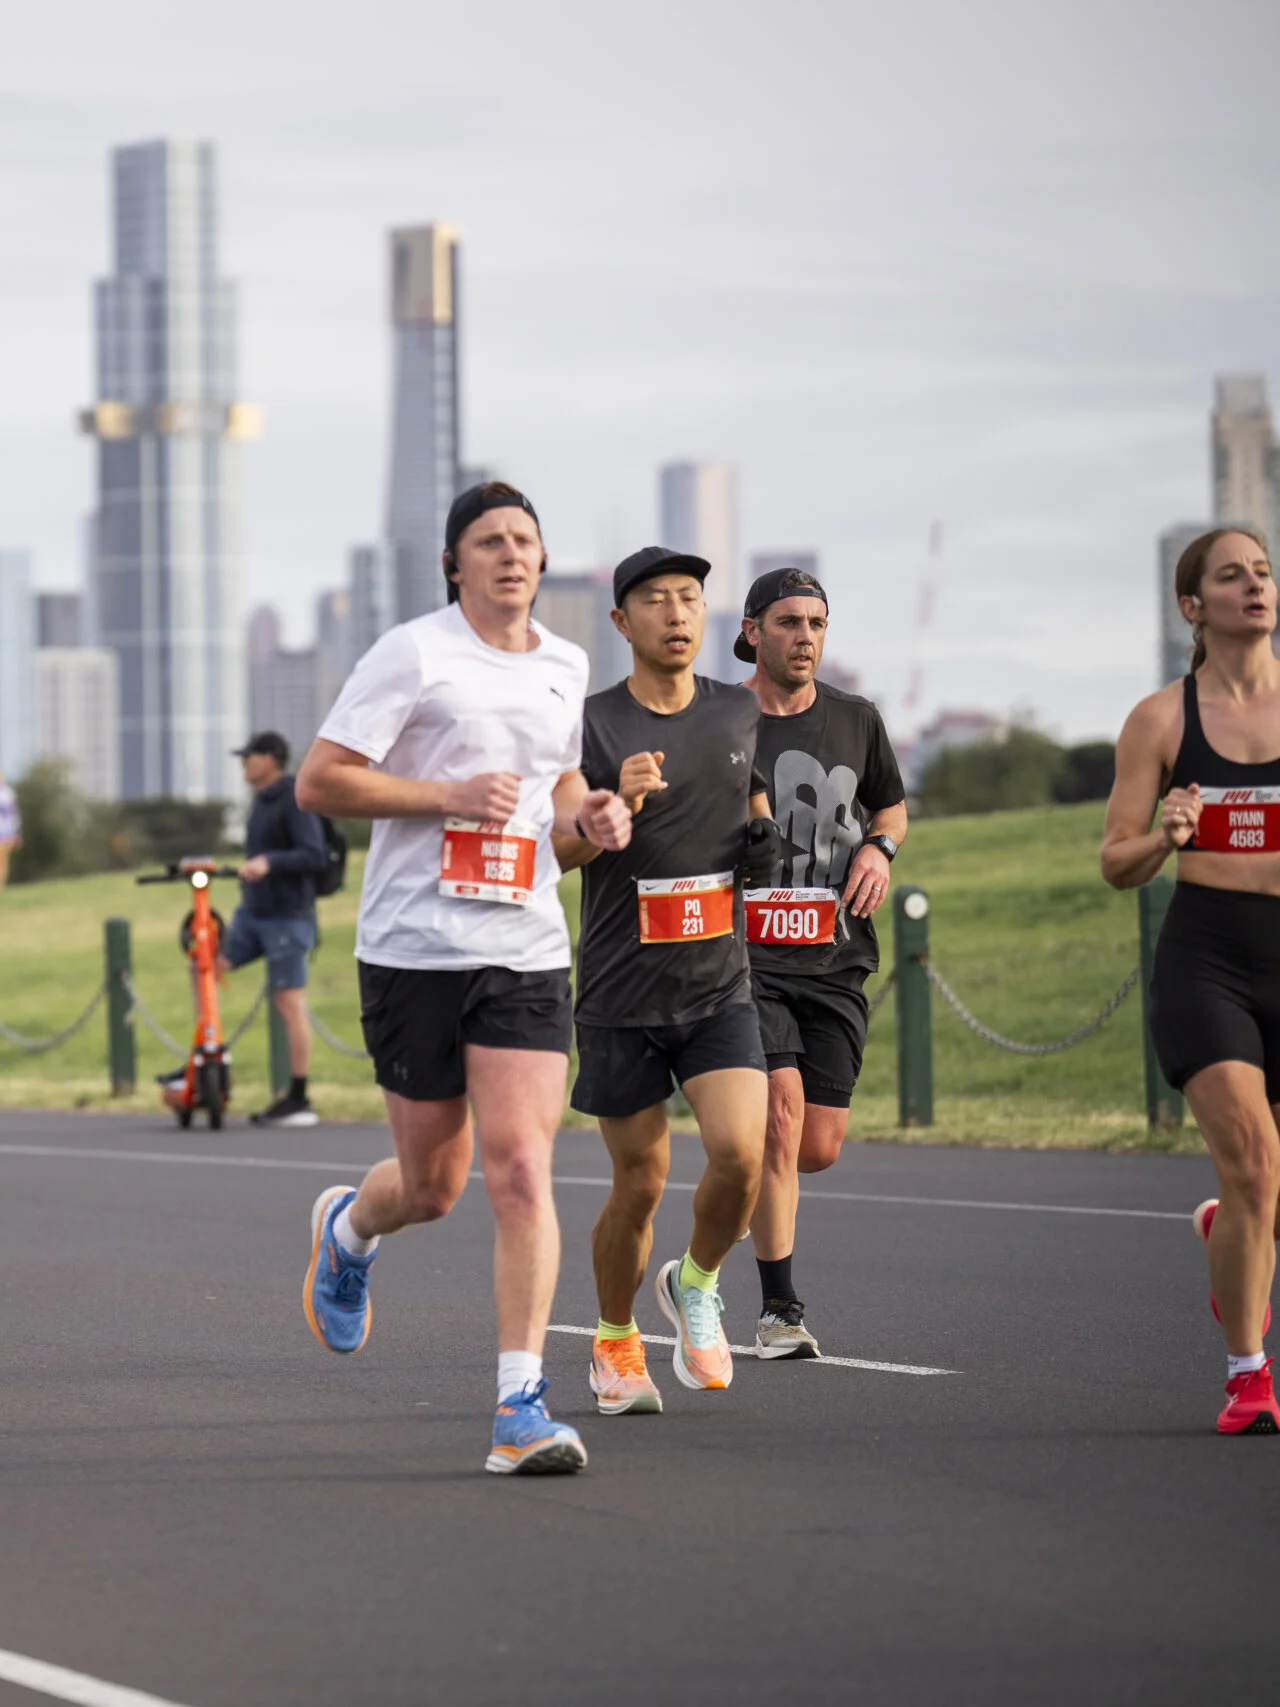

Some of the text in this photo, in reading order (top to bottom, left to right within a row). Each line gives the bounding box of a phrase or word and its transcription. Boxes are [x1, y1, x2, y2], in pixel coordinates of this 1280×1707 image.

[1228, 809, 1265, 828] RYANN
[1228, 829, 1265, 848] 4583
[684, 899, 701, 916] PQ
[682, 917, 704, 935] 231
[757, 908, 819, 939] 7090
